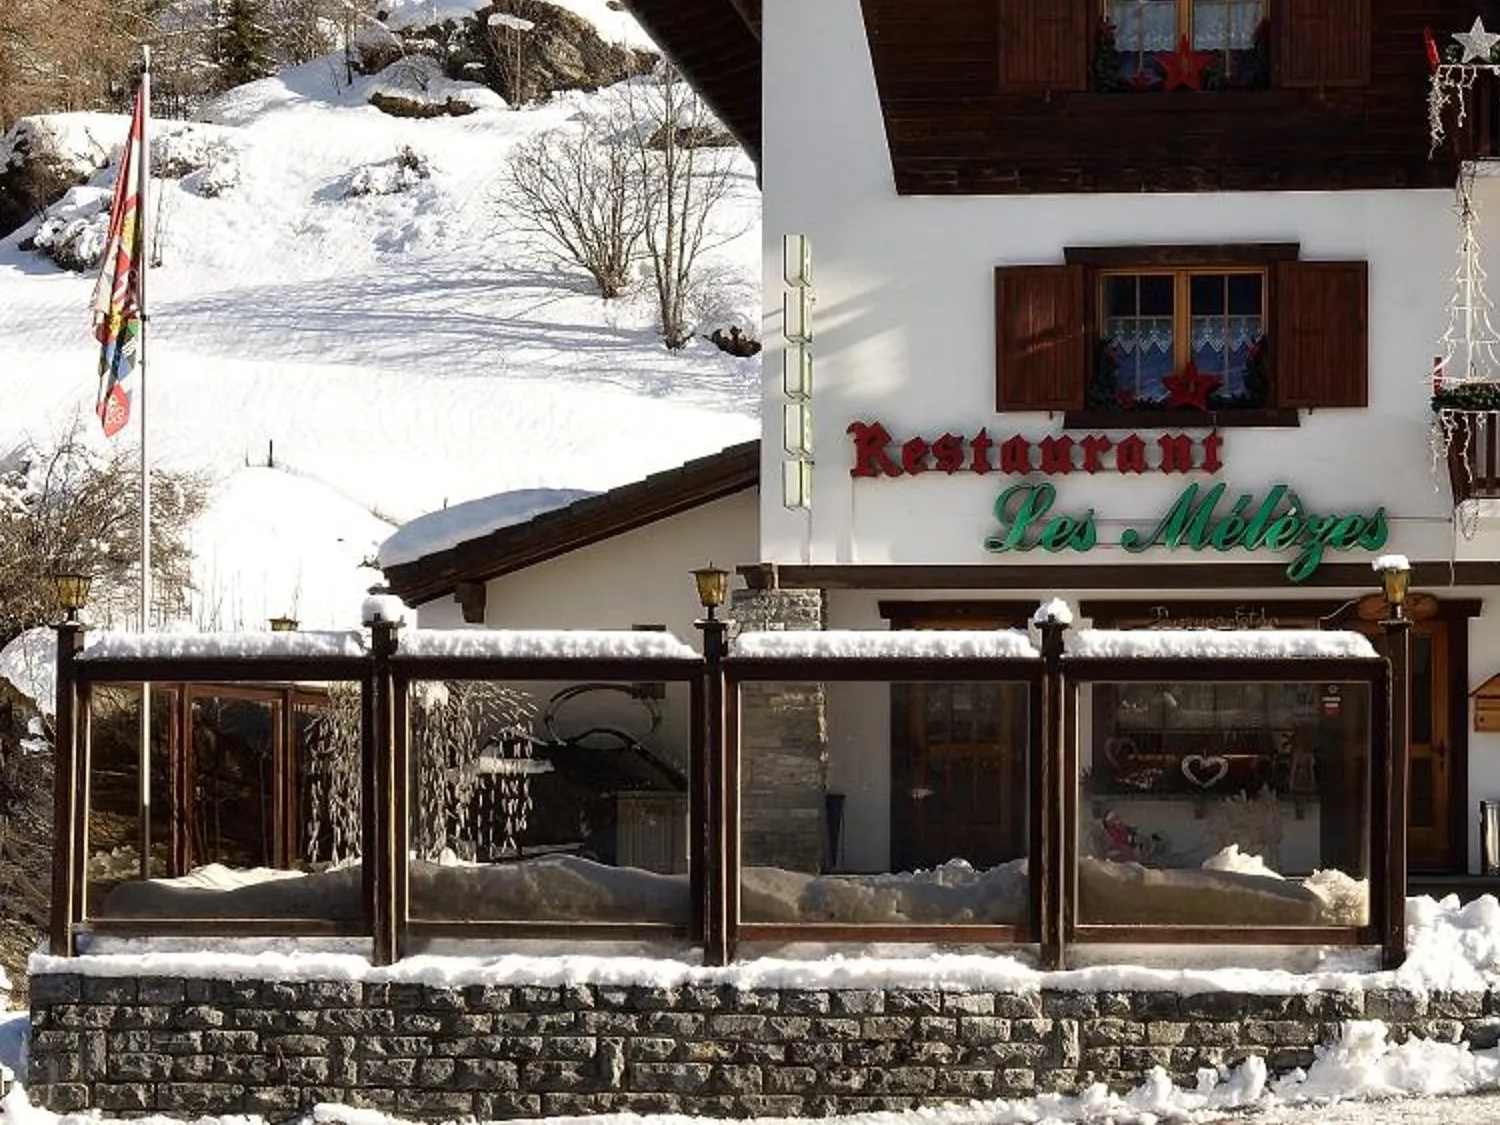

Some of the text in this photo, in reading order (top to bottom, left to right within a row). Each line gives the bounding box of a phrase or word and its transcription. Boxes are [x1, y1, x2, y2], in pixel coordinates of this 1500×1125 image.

[847, 422, 1223, 477] Restaurant
[984, 482, 1390, 582] Les Mélèzes
